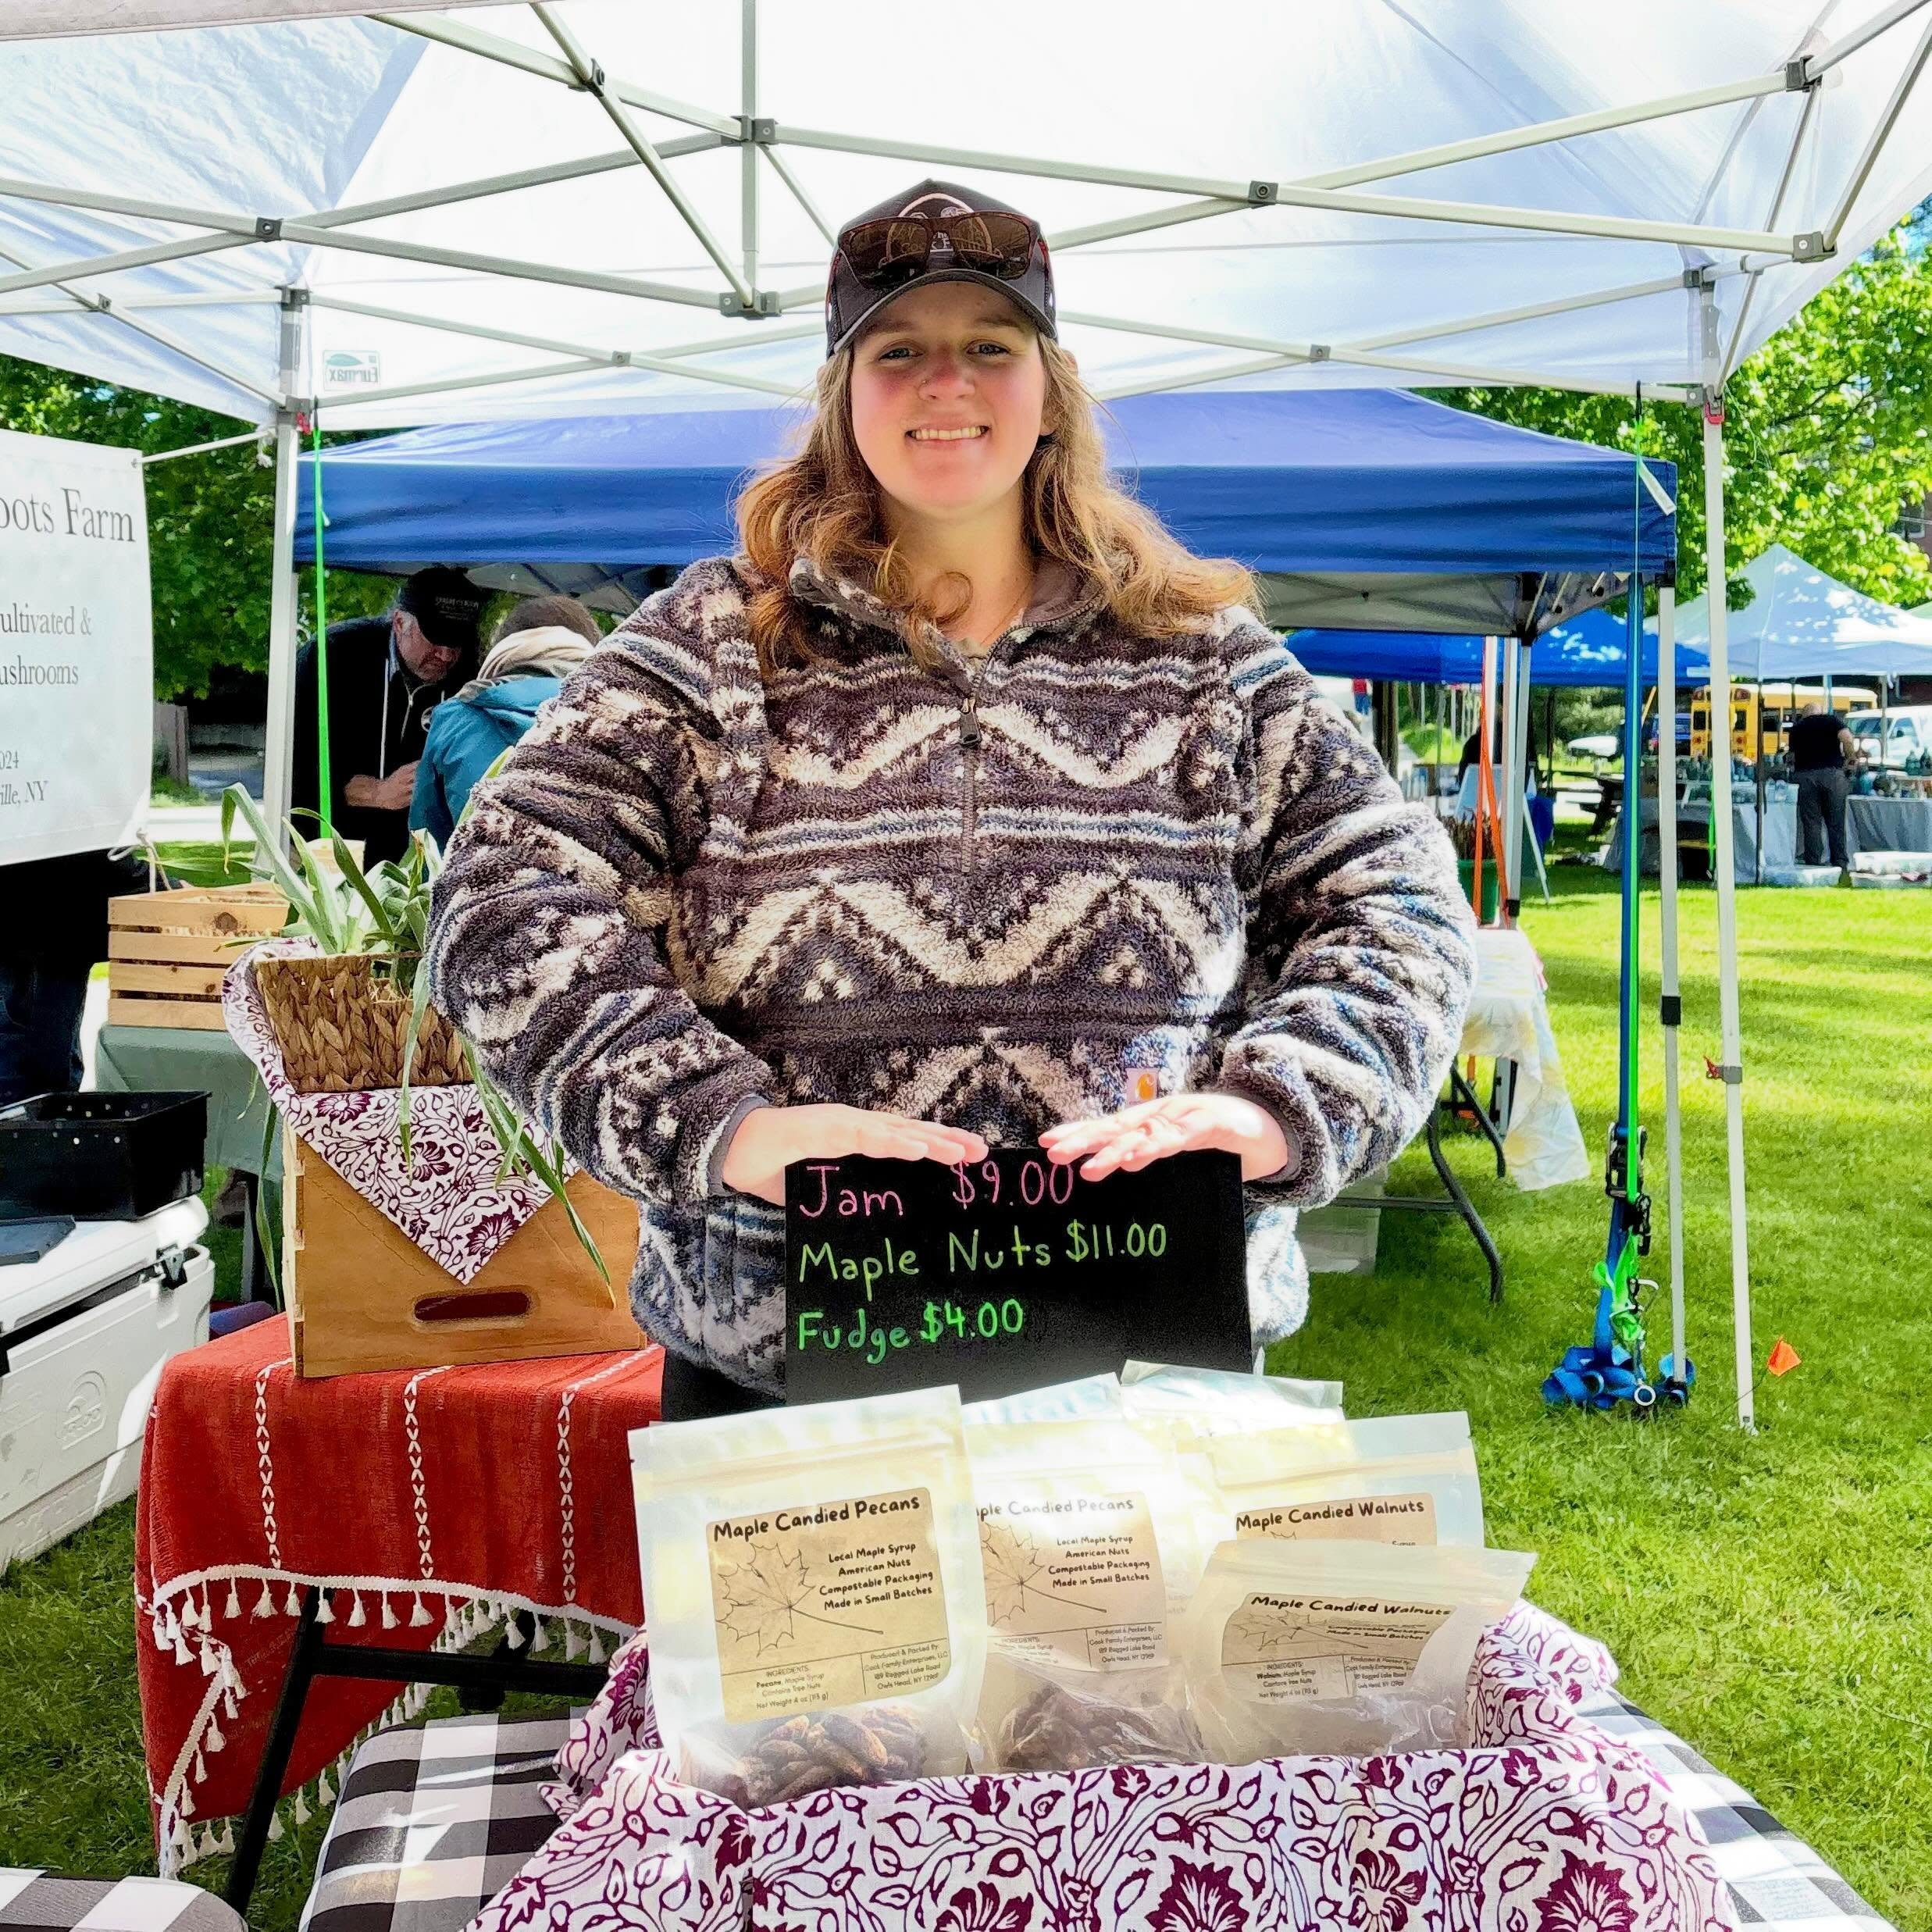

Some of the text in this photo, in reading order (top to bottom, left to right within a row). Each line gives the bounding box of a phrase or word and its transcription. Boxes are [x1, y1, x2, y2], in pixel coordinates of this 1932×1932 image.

[60, 487, 136, 542] Farm
[80, 607, 91, 636] &
[25, 780, 48, 802] NY
[799, 1160, 1074, 1218] Jam $9.00
[799, 1218, 1167, 1302] Maple Nuts $11.00
[798, 1298, 1024, 1364] Fudge $4.00
[714, 1518, 768, 1542] Maple
[775, 1503, 850, 1531] Candied
[855, 1496, 920, 1519] Pecans
[976, 1499, 1133, 1522] ple Candied Pecans
[1236, 1501, 1424, 1531] Maple Candied Walnuts
[1081, 1537, 1106, 1545] Maple
[829, 1543, 915, 1563] Local Maple Syrup
[839, 1559, 911, 1576] American Nuts
[1049, 1561, 1150, 1574] Compostable Packaging
[820, 1571, 933, 1595] Compostable Packaging
[1053, 1578, 1077, 1588] Made
[1090, 1576, 1112, 1584] Small
[1115, 1573, 1150, 1582] Batches
[825, 1599, 850, 1610] Made
[865, 1592, 890, 1604] Small
[893, 1587, 932, 1599] Batches
[1251, 1596, 1451, 1615] Maple Candied Walnuts
